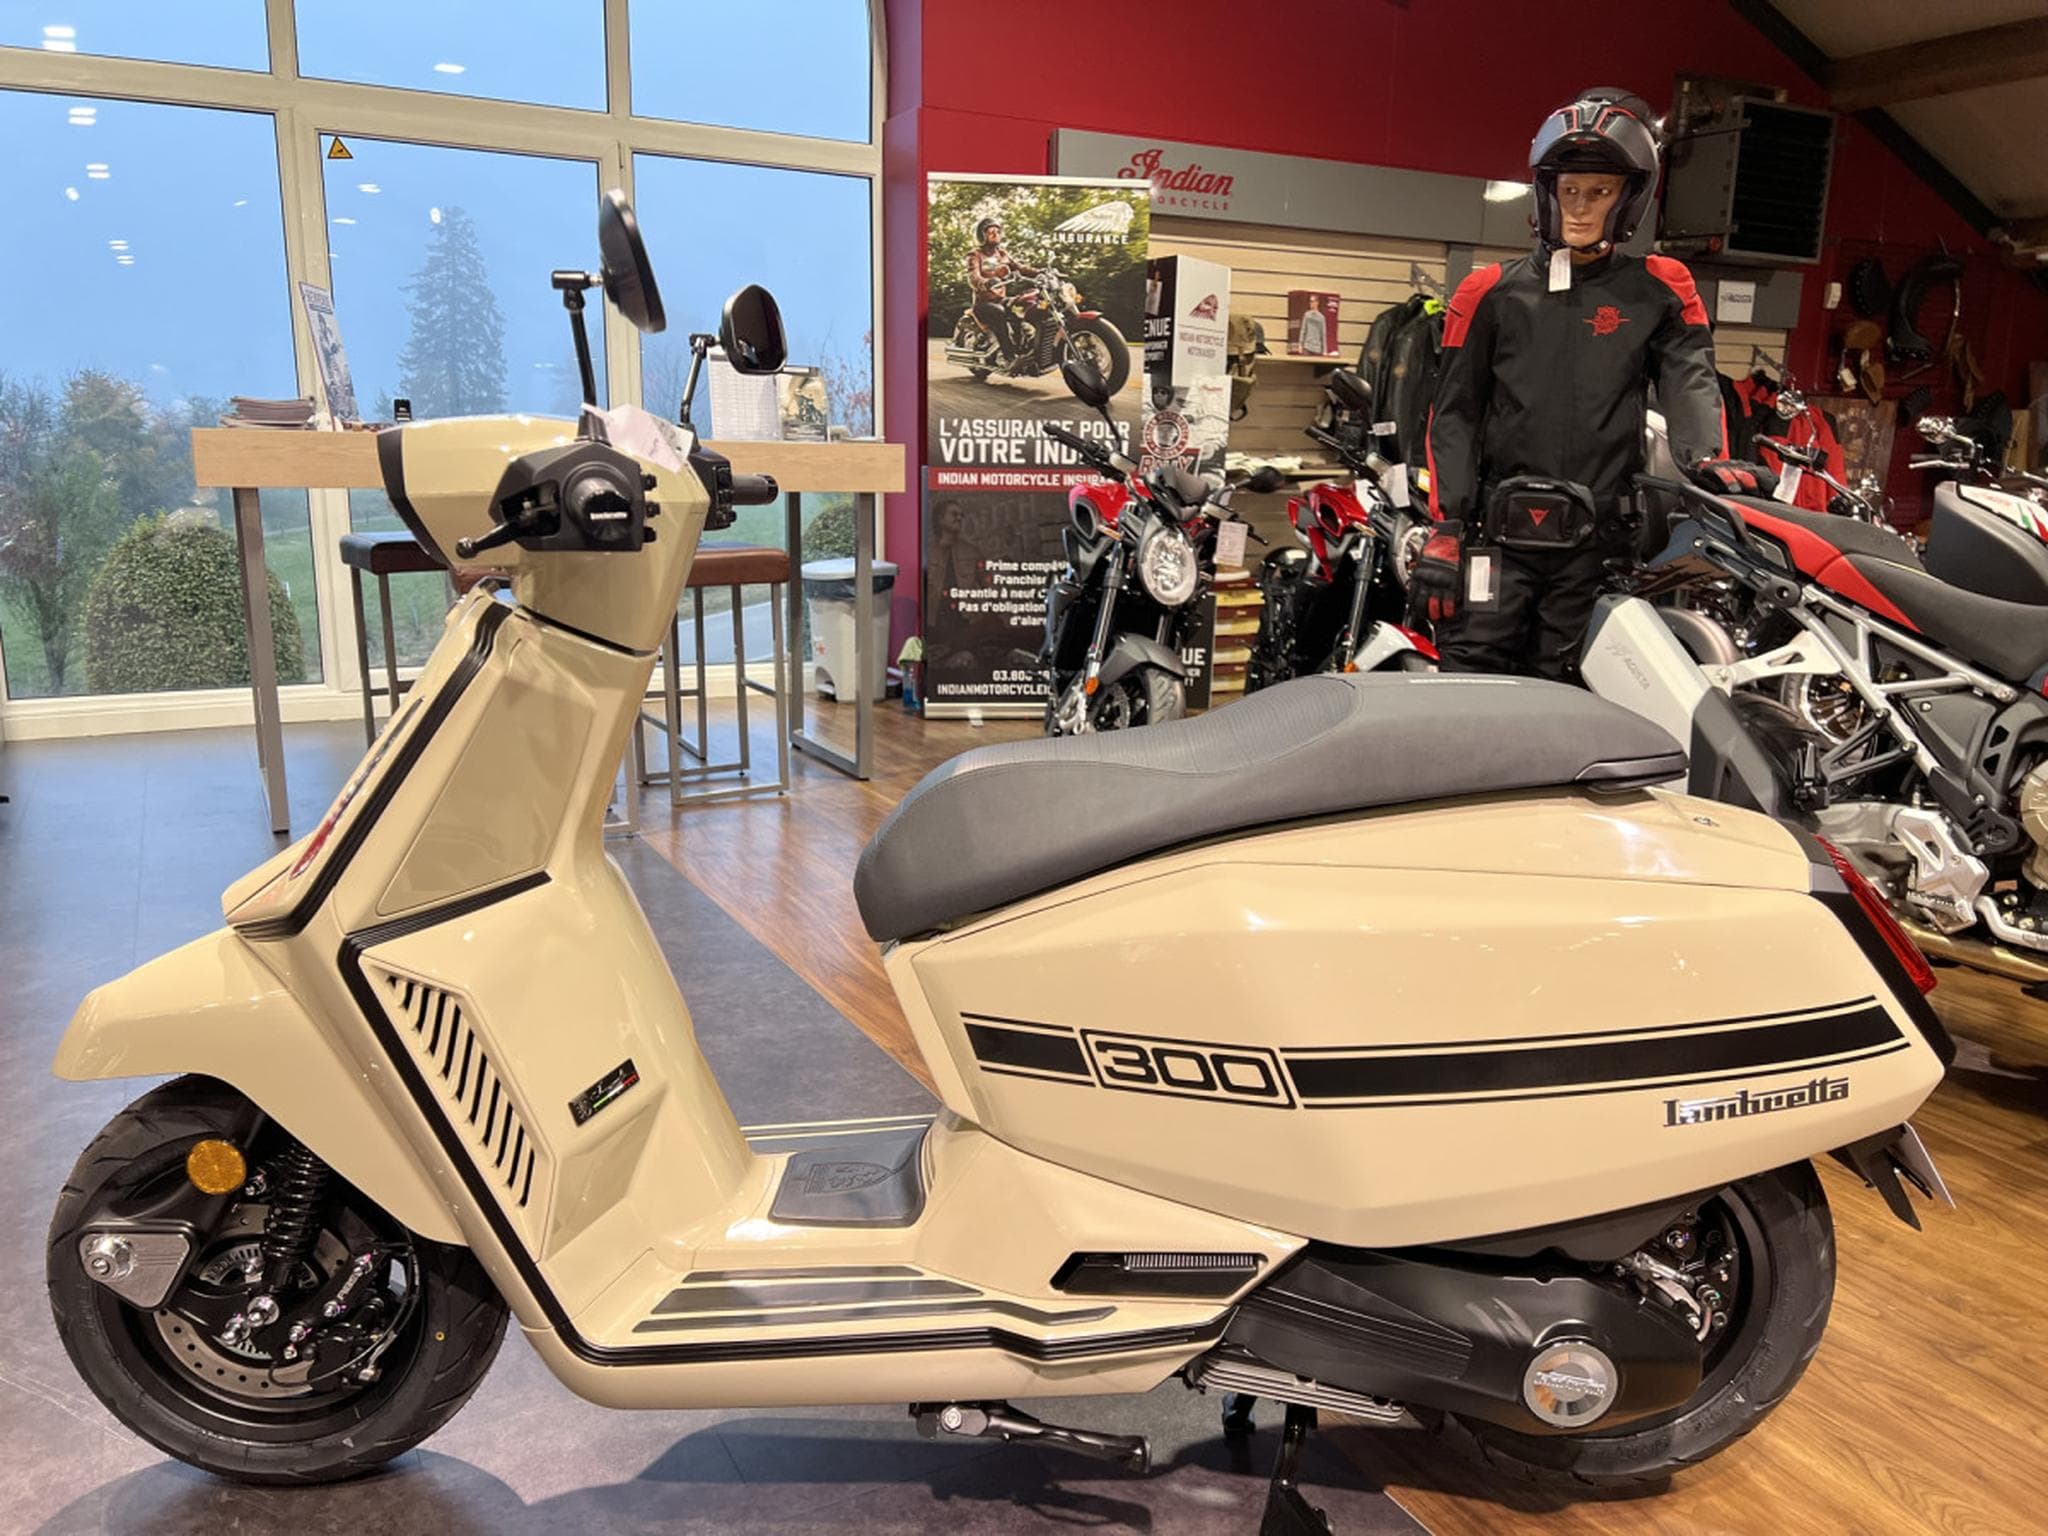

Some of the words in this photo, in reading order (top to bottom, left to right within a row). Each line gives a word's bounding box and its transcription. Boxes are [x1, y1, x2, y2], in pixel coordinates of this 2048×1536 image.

[1117, 149, 1234, 196] Indian
[1053, 232, 1129, 245] INSURANCE
[1080, 420, 1130, 439] POUR
[940, 438, 1026, 464] VOTRE
[938, 472, 978, 485] INDIAN
[981, 473, 1060, 487] MOTORCYCLE
[985, 560, 1018, 571] Prime
[950, 587, 998, 599] Garantie
[958, 602, 979, 612] Pas
[981, 601, 1046, 614] d'obligation
[1095, 1040, 1280, 1097] 300
[1663, 1077, 1849, 1127] Lambretta
